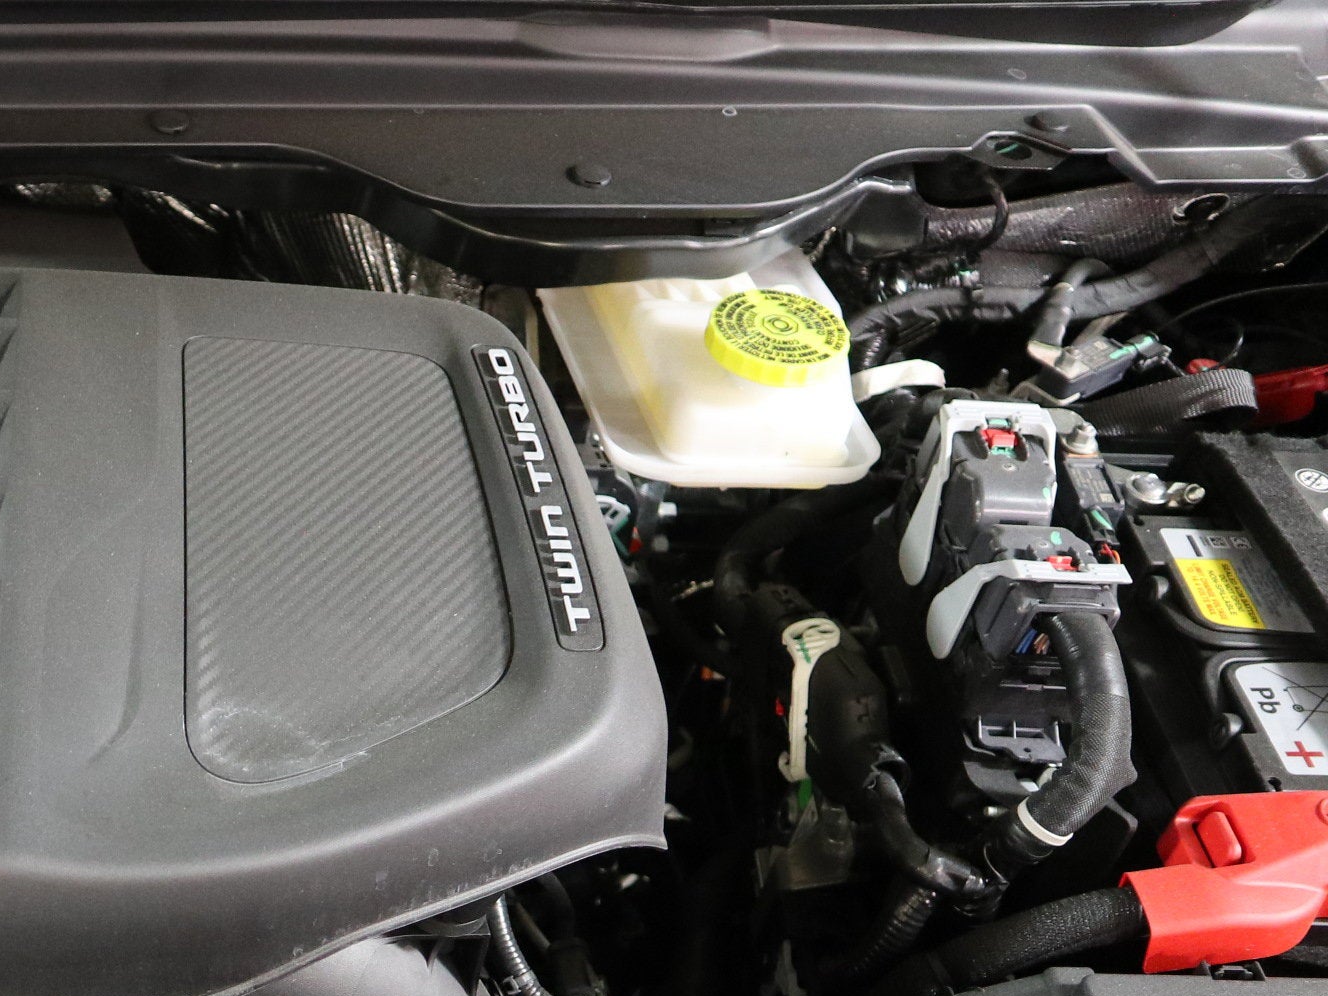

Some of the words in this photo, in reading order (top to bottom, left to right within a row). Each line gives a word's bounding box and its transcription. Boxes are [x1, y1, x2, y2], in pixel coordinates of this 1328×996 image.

[488, 348, 552, 492] TURBO
[540, 505, 591, 631] TWIN
[1250, 687, 1281, 714] Pb
